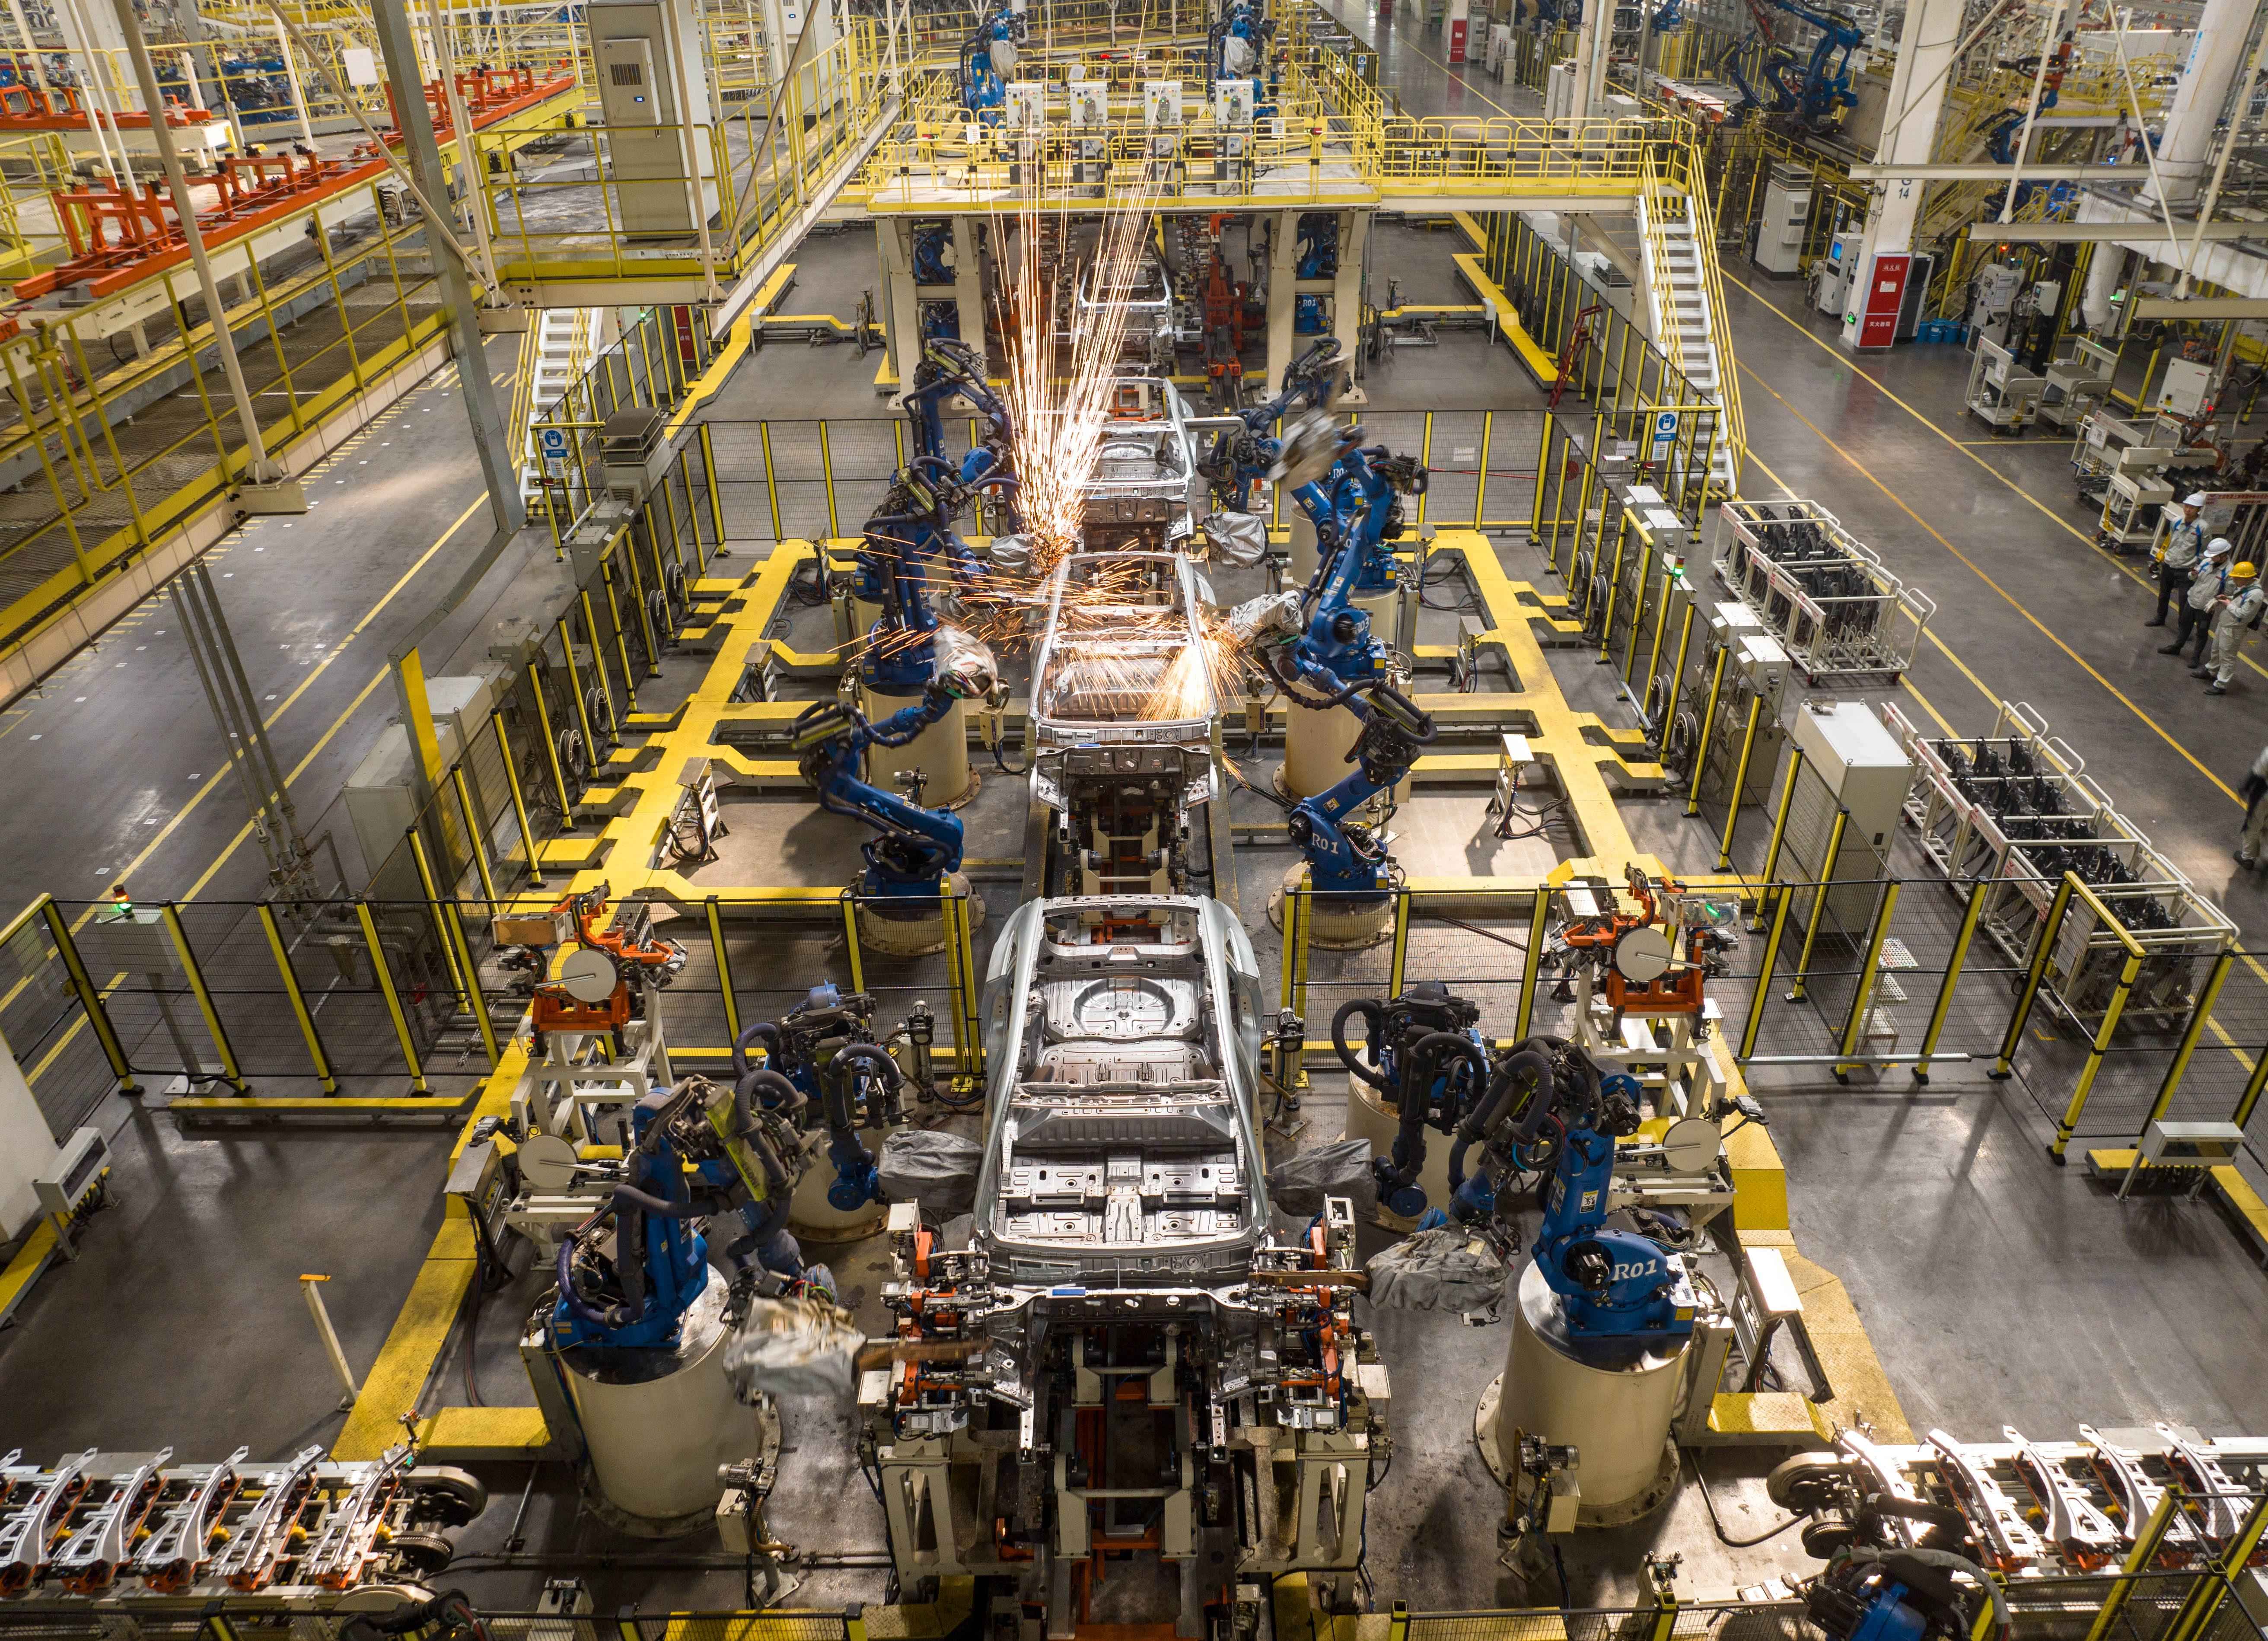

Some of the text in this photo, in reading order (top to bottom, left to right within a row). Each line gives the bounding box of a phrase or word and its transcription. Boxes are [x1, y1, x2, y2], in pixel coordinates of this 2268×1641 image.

[1899, 188, 1909, 199] 14
[1303, 299, 1316, 307] R01
[1333, 468, 1348, 479] R0
[1311, 833, 1338, 854] R01
[1611, 1259, 1657, 1281] R01
